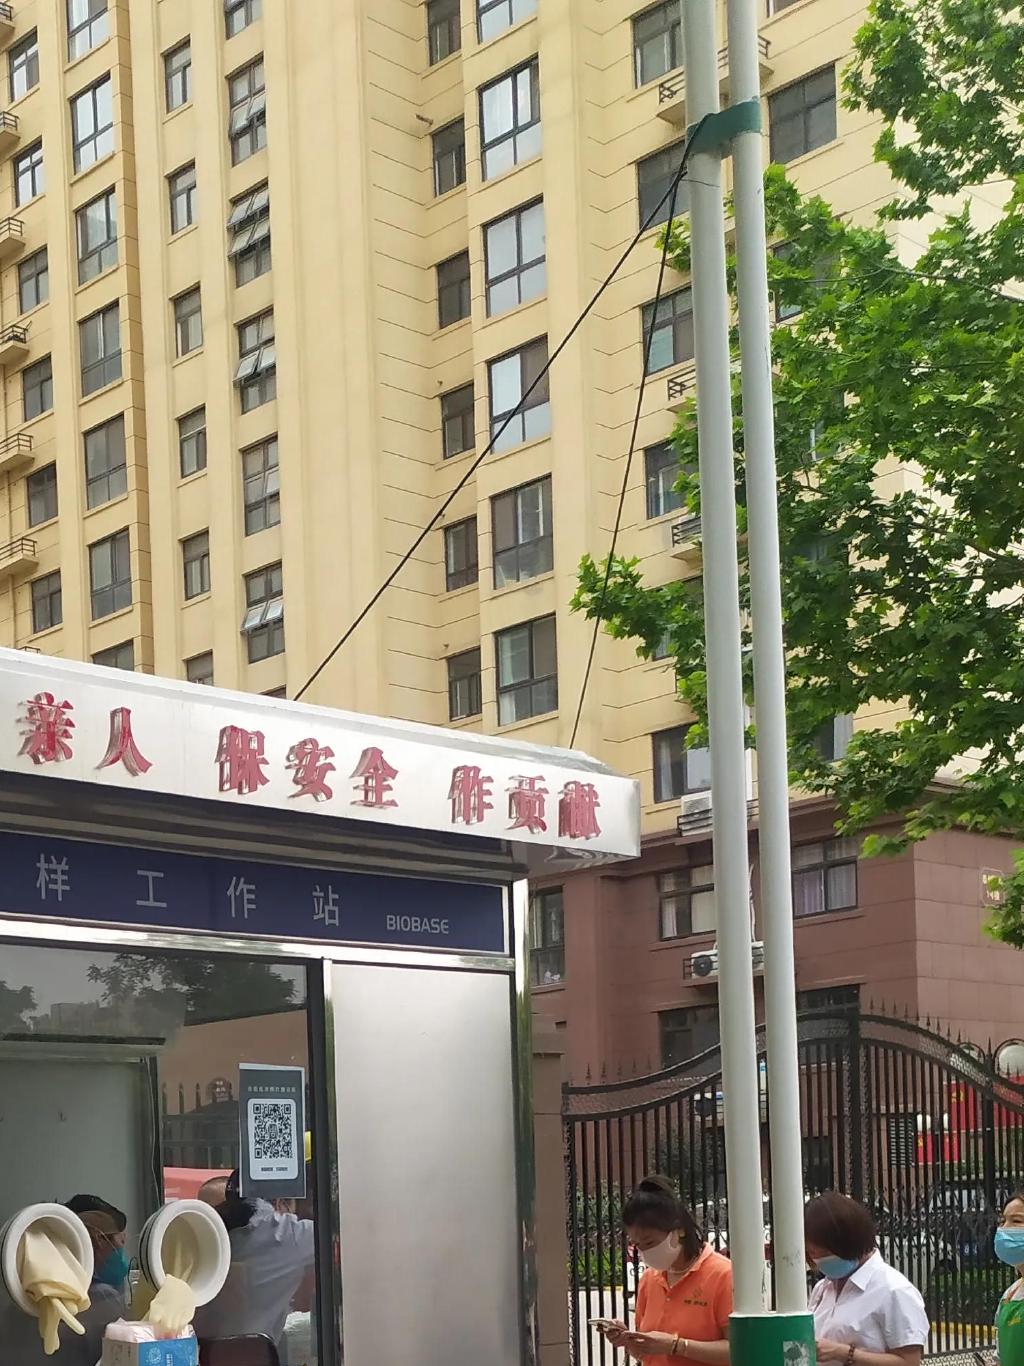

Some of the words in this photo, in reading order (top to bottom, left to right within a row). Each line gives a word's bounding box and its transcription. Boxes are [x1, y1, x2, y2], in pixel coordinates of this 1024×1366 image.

[215, 724, 399, 811] 保安全
[448, 764, 602, 841] 作贡献
[385, 914, 451, 935] BIOBASE
